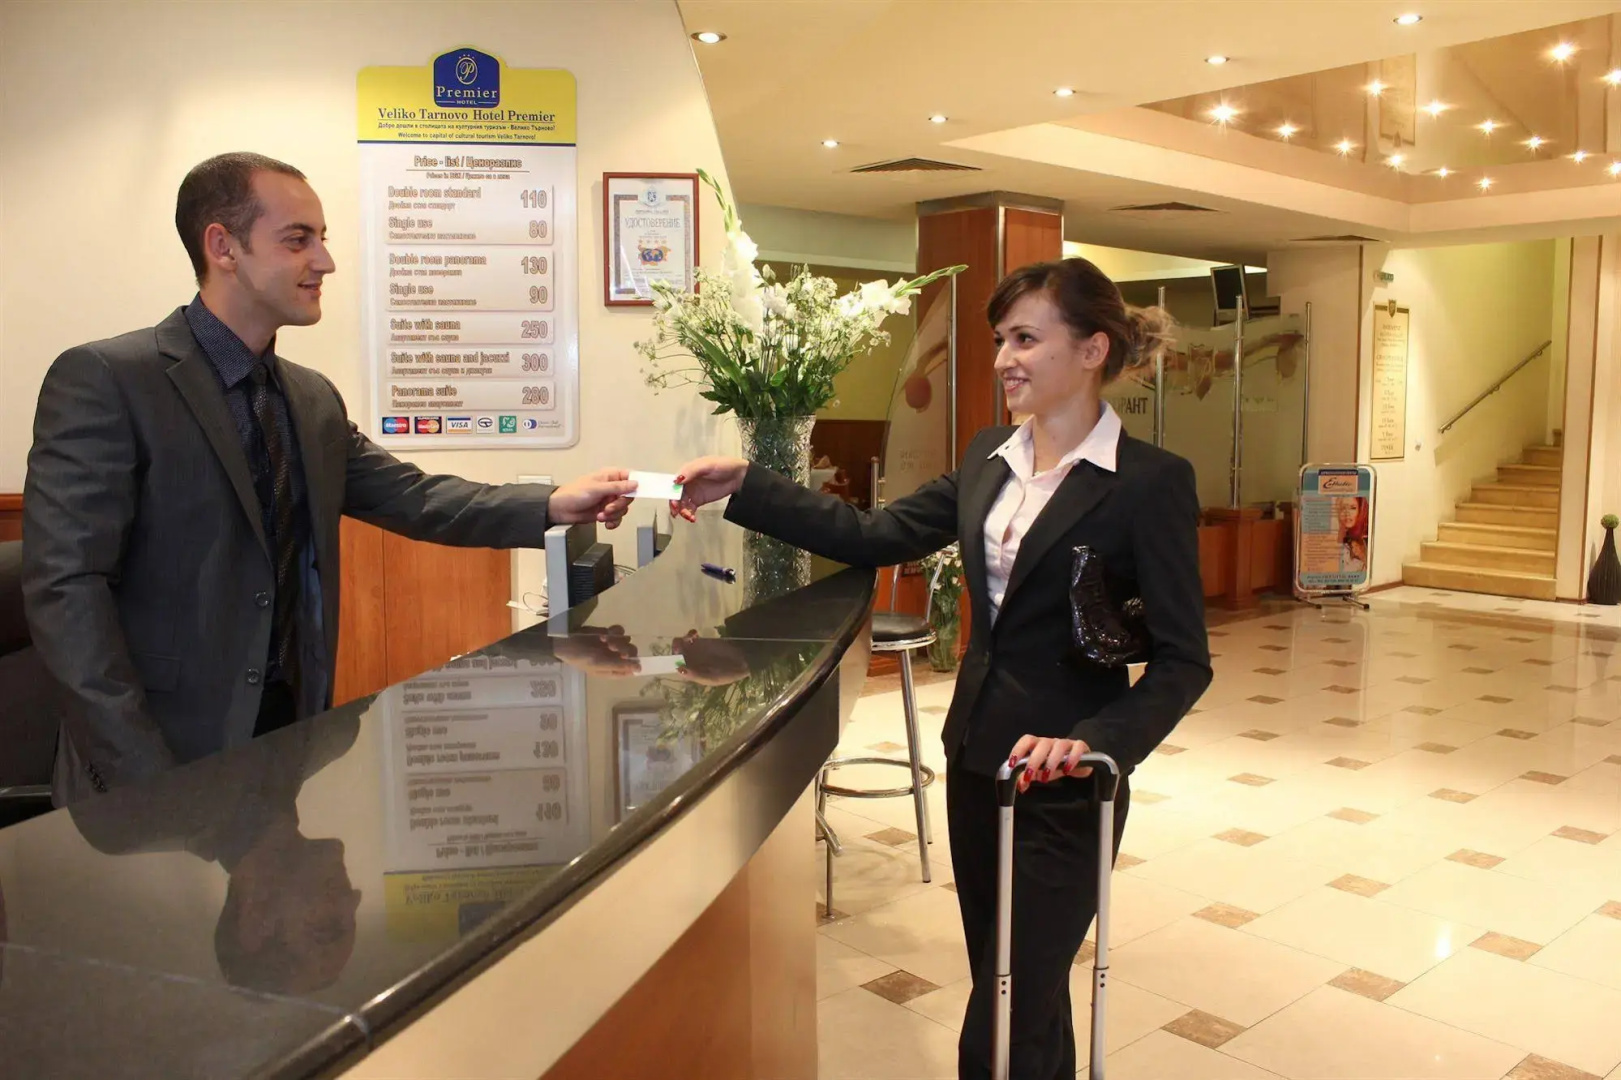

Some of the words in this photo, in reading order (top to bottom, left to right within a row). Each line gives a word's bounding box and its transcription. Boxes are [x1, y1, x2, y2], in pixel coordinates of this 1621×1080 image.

[436, 85, 498, 98] Premier
[378, 107, 416, 119] Veliko
[419, 108, 468, 120] Tarnovo
[473, 109, 504, 121] Hotel
[508, 110, 555, 122] Premier
[414, 155, 438, 168] Price
[444, 155, 459, 168] list
[466, 156, 523, 170] Ценоразпис
[388, 185, 418, 198] Double
[420, 188, 442, 198] room
[443, 186, 482, 199] standard
[520, 189, 547, 209] 110
[388, 216, 416, 231] Single
[417, 218, 433, 228] use
[529, 219, 548, 239] 80
[389, 252, 419, 265] Double
[420, 255, 442, 265] room
[444, 254, 487, 267] panorama
[520, 256, 548, 275] 130
[389, 282, 416, 297] Single
[417, 285, 434, 295] use
[529, 285, 548, 304] 90
[390, 318, 413, 330] Suite
[414, 318, 434, 330] with
[435, 320, 461, 330] sauna
[521, 320, 548, 338] 250
[390, 351, 413, 363] Suite
[415, 351, 434, 363] with
[435, 353, 461, 363] sauna
[463, 352, 478, 363] and
[479, 351, 510, 365] jacuzzi
[521, 353, 549, 372] 300
[391, 384, 434, 397] Panorama
[436, 384, 458, 397] suite
[521, 386, 549, 404] 280
